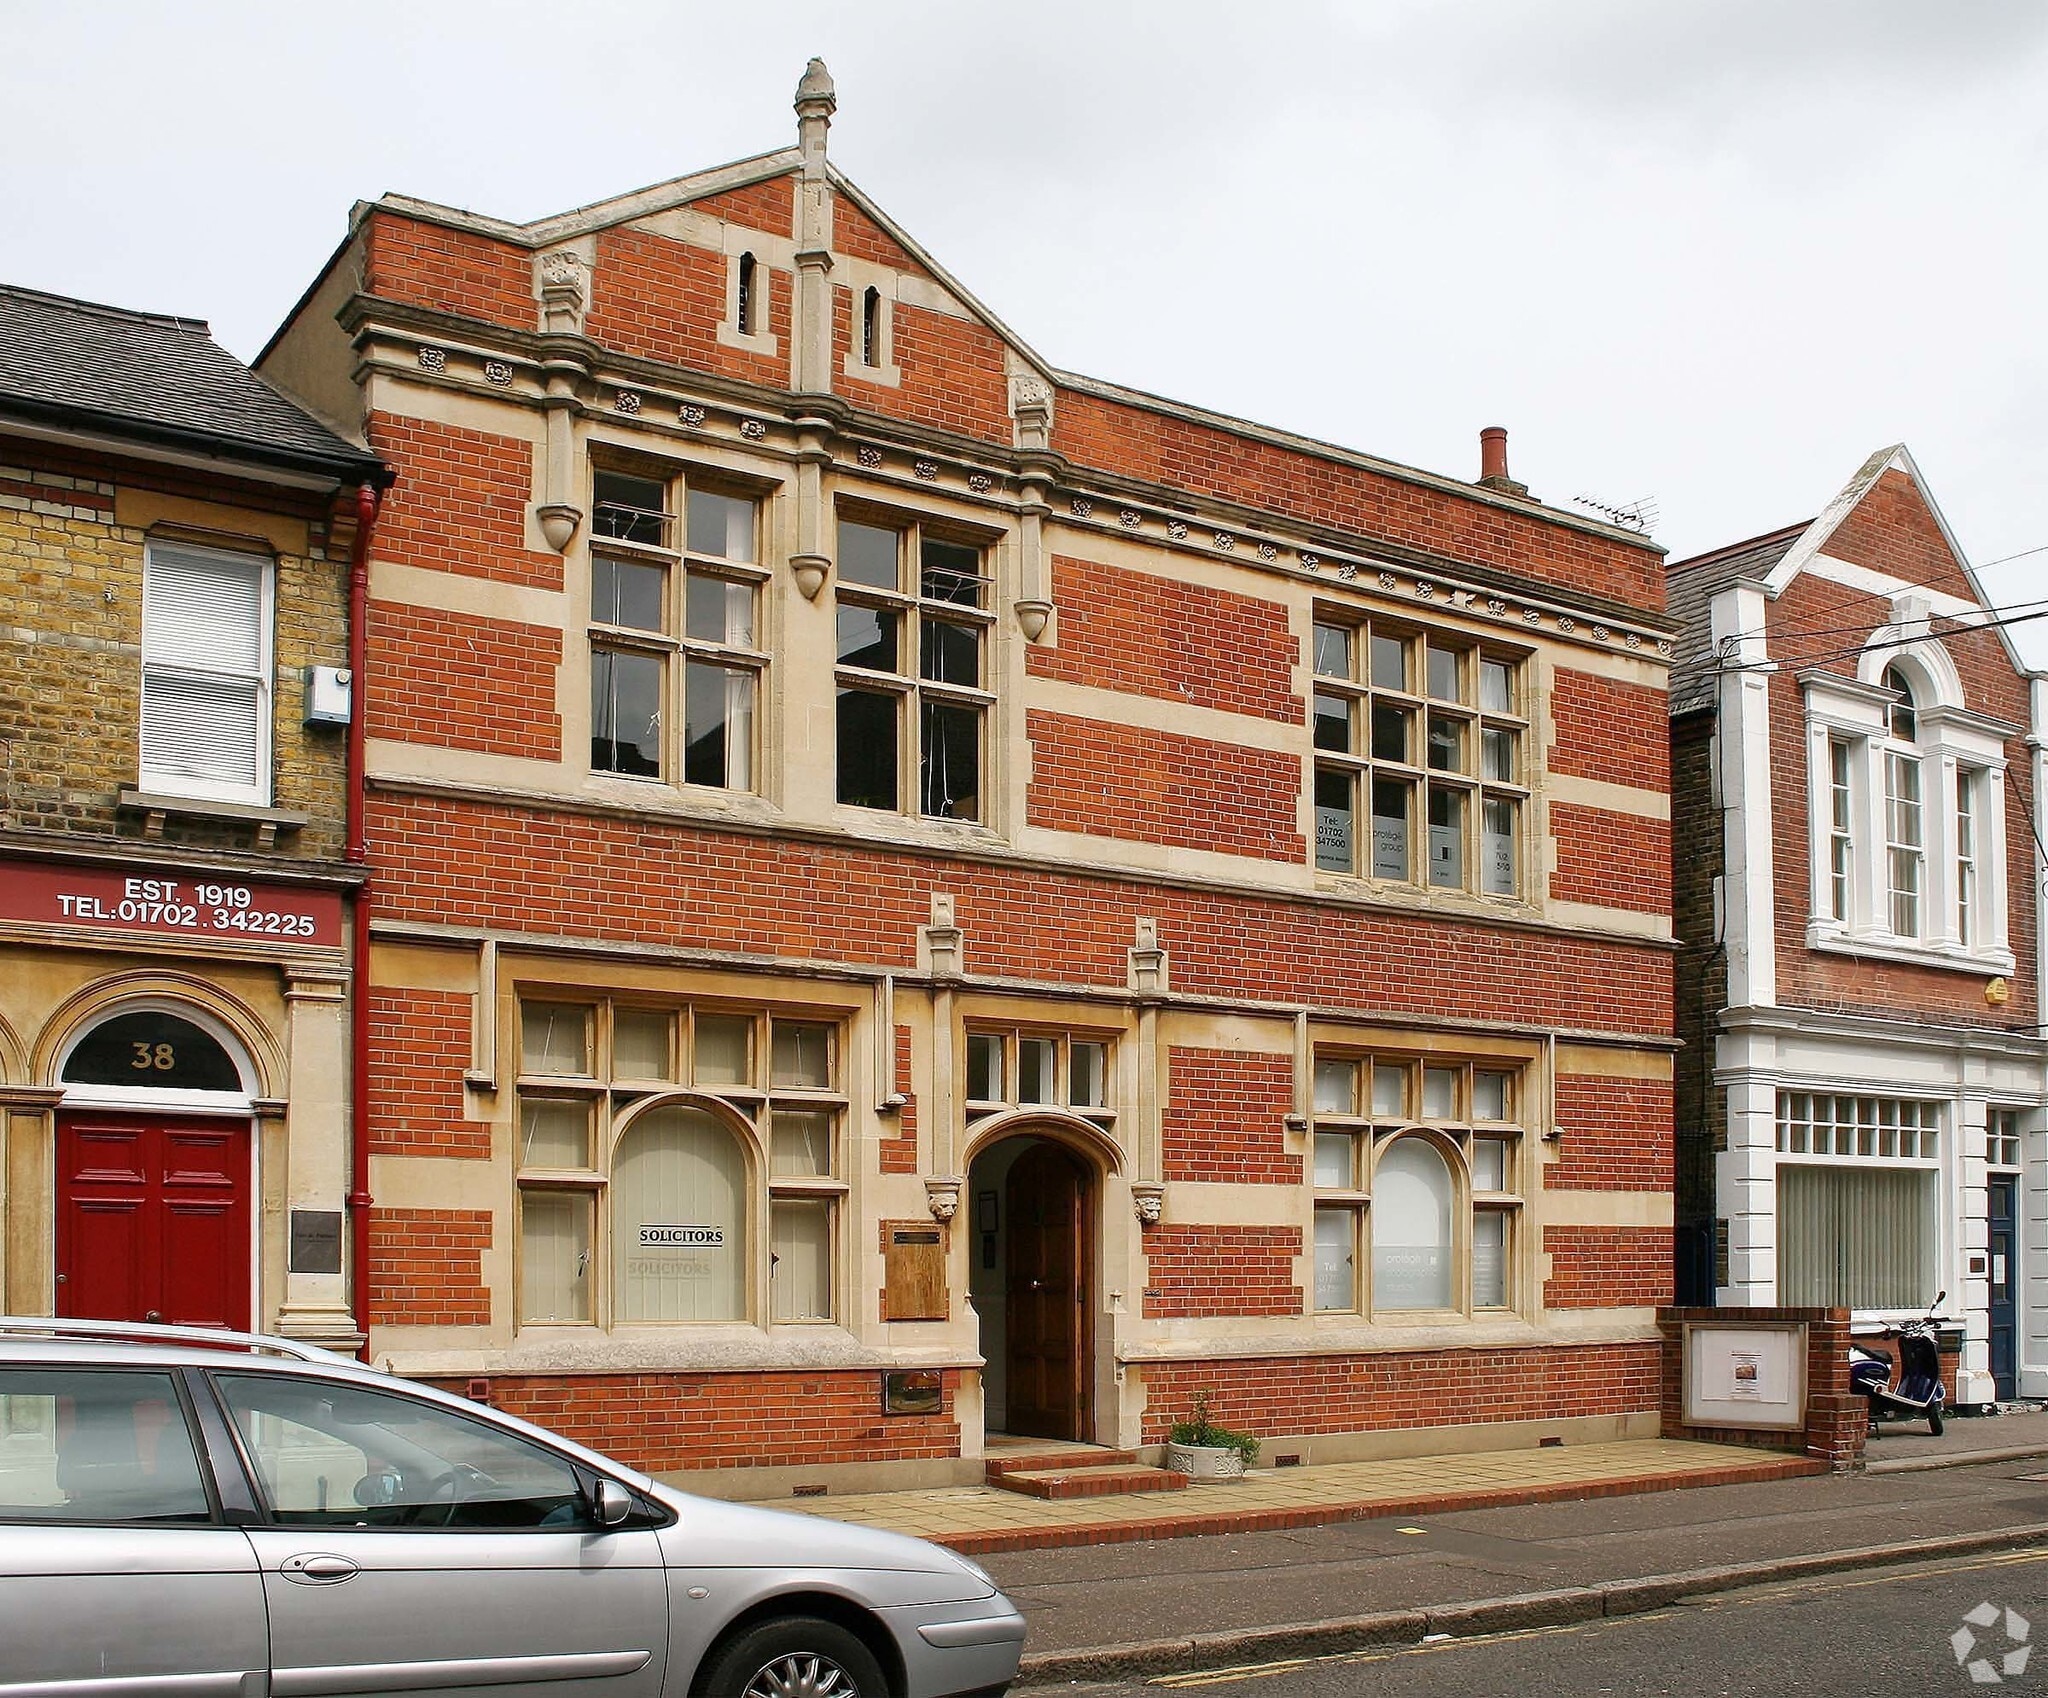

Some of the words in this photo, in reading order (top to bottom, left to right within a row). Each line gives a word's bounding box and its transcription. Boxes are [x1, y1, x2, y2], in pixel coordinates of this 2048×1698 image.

[1318, 826, 1344, 838] 01702
[1315, 836, 1346, 849] 347500
[125, 877, 183, 903] EST.
[193, 883, 253, 909] 1919
[131, 1042, 175, 1070] 38
[640, 1230, 724, 1243] SOLICITORS
